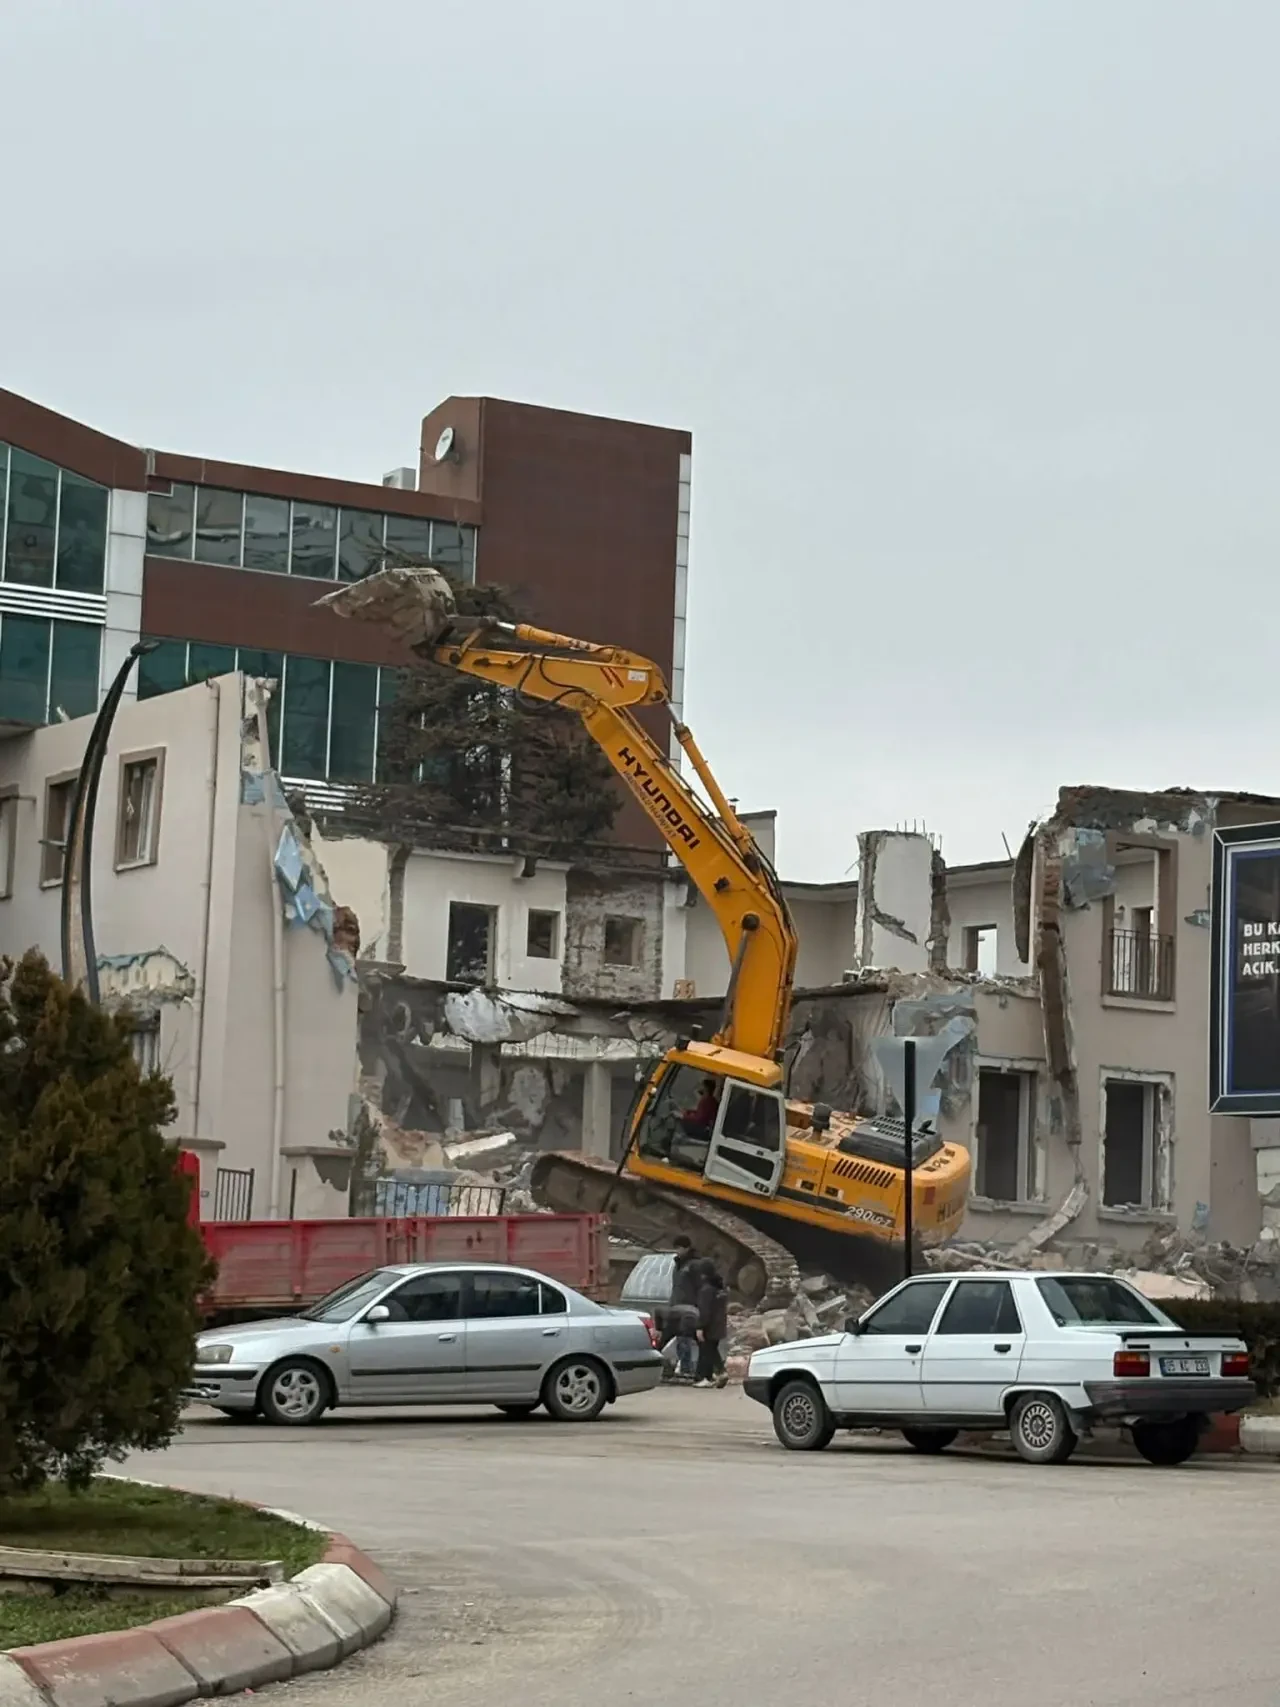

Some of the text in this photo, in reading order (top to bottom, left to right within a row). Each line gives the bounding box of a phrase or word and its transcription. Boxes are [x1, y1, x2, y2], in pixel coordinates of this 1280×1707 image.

[618, 747, 700, 849] HYUNDAI
[1243, 921, 1280, 937] BU K
[1243, 942, 1280, 956] HERK
